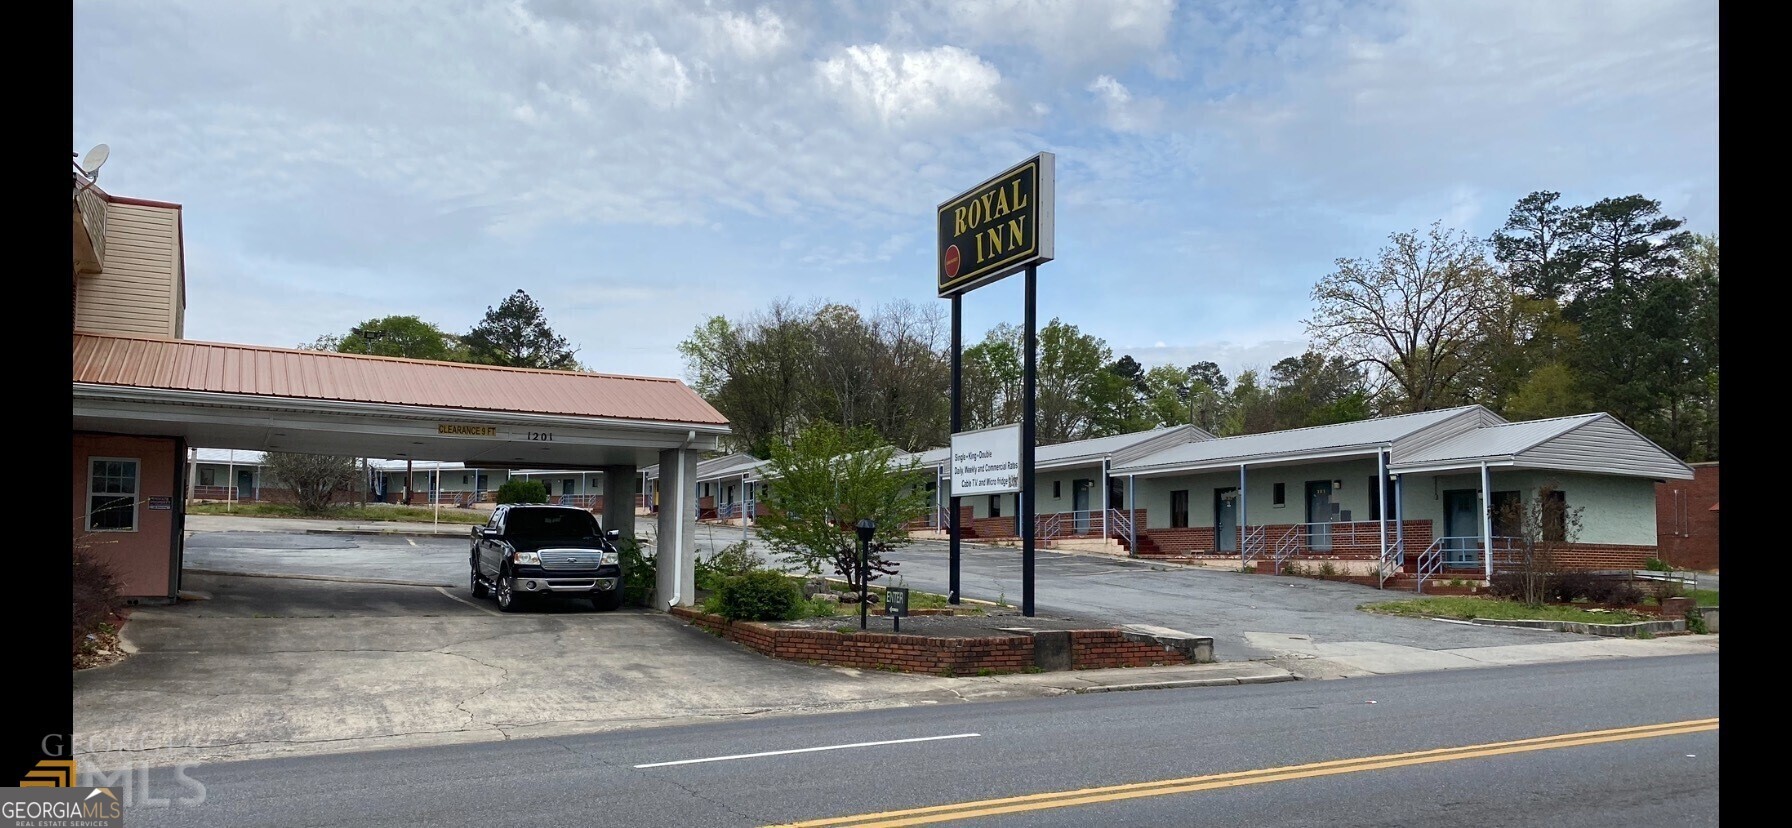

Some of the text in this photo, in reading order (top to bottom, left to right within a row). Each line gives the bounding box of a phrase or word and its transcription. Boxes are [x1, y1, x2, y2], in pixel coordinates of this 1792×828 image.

[954, 179, 1027, 237] ROYAL
[975, 215, 1026, 263] INN
[439, 424, 496, 436] CLEARANCE 9 FT
[527, 432, 553, 441] 1201
[977, 464, 985, 473] and
[985, 462, 1007, 472] Commercial
[1007, 461, 1019, 470] Rates
[961, 479, 972, 488] Cable
[978, 478, 986, 487] and
[986, 477, 997, 486] Micro
[886, 591, 904, 604] ENTER
